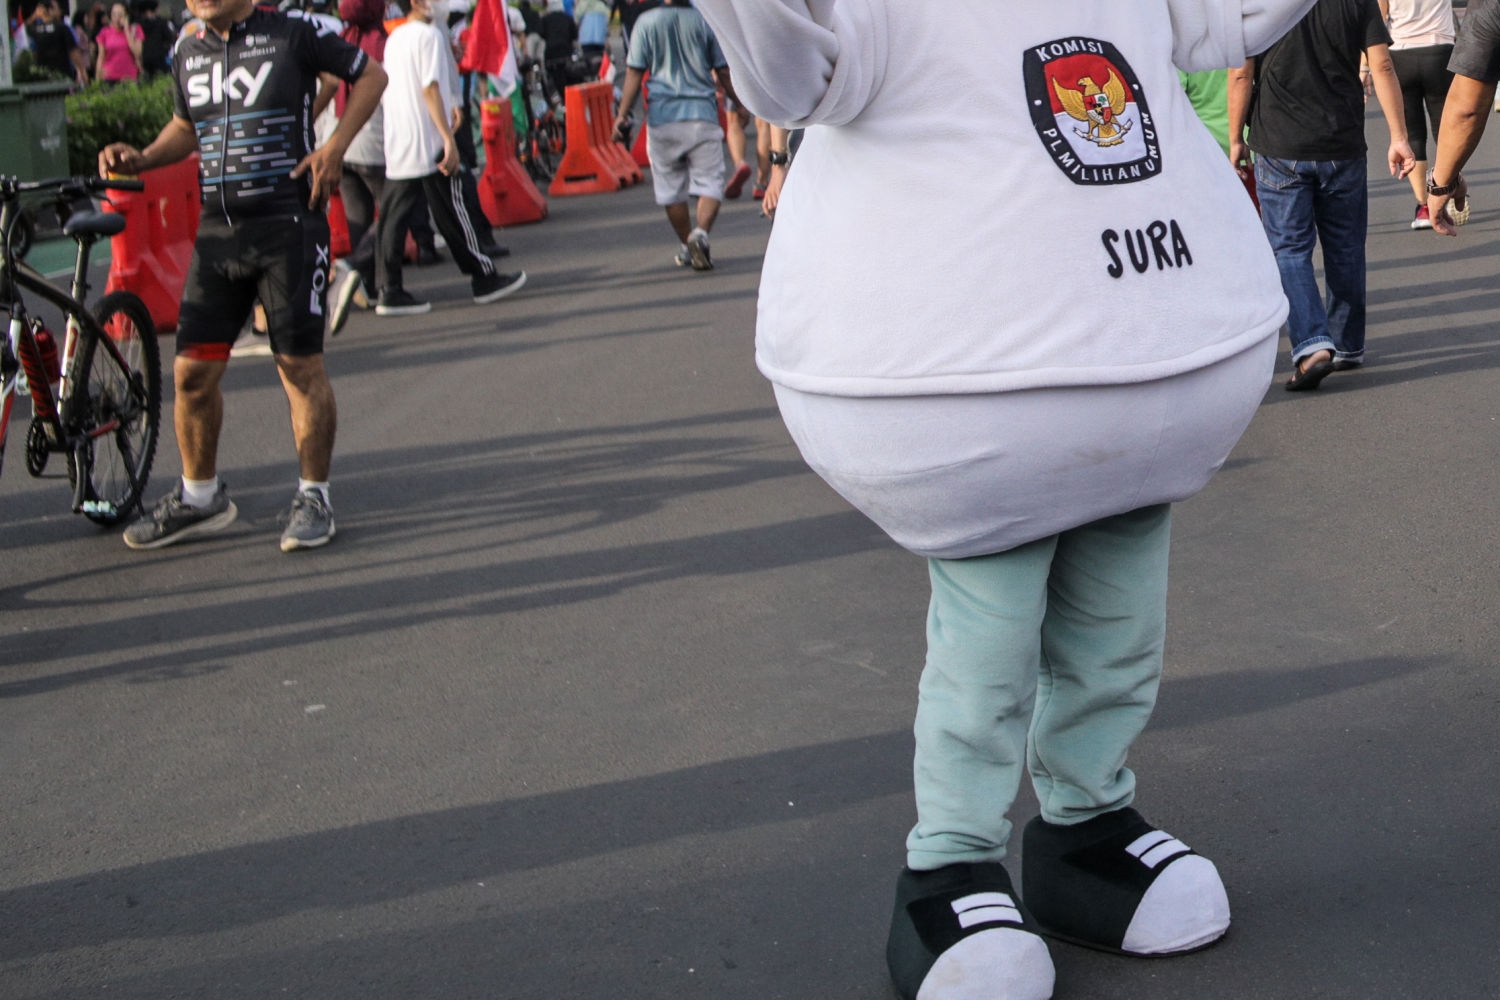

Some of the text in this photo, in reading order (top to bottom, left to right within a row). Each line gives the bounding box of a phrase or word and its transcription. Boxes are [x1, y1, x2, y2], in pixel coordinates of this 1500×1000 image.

[1035, 39, 1105, 62] KOMISI
[187, 61, 273, 107] sky
[1101, 218, 1193, 279] SURA
[309, 243, 329, 316] FOX
